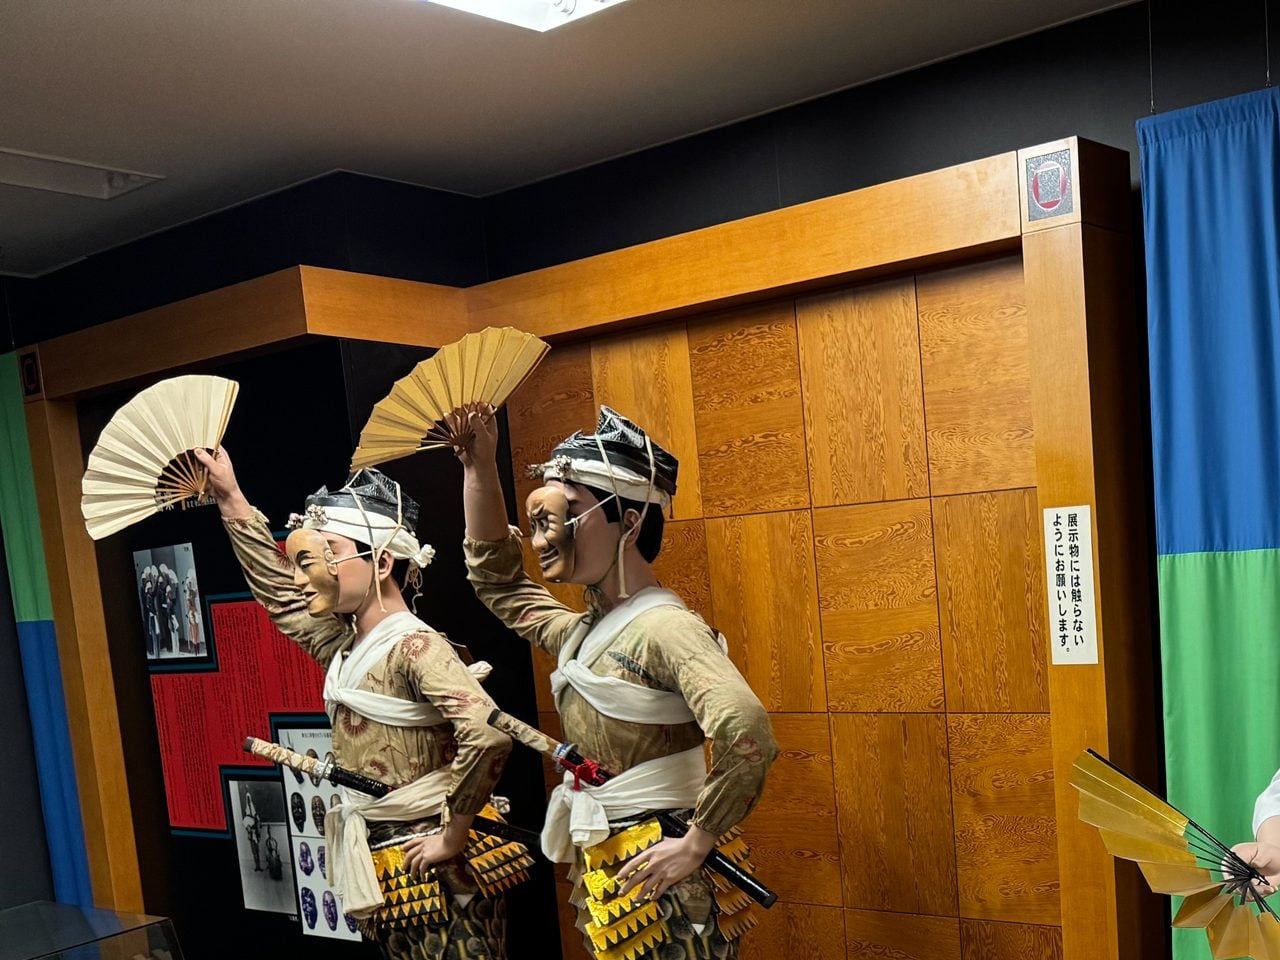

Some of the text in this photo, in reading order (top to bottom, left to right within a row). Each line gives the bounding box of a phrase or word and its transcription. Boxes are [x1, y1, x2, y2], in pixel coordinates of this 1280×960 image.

[1052, 513, 1070, 653] ようにお願いします。
[1067, 513, 1085, 646] 展示物には触らない
